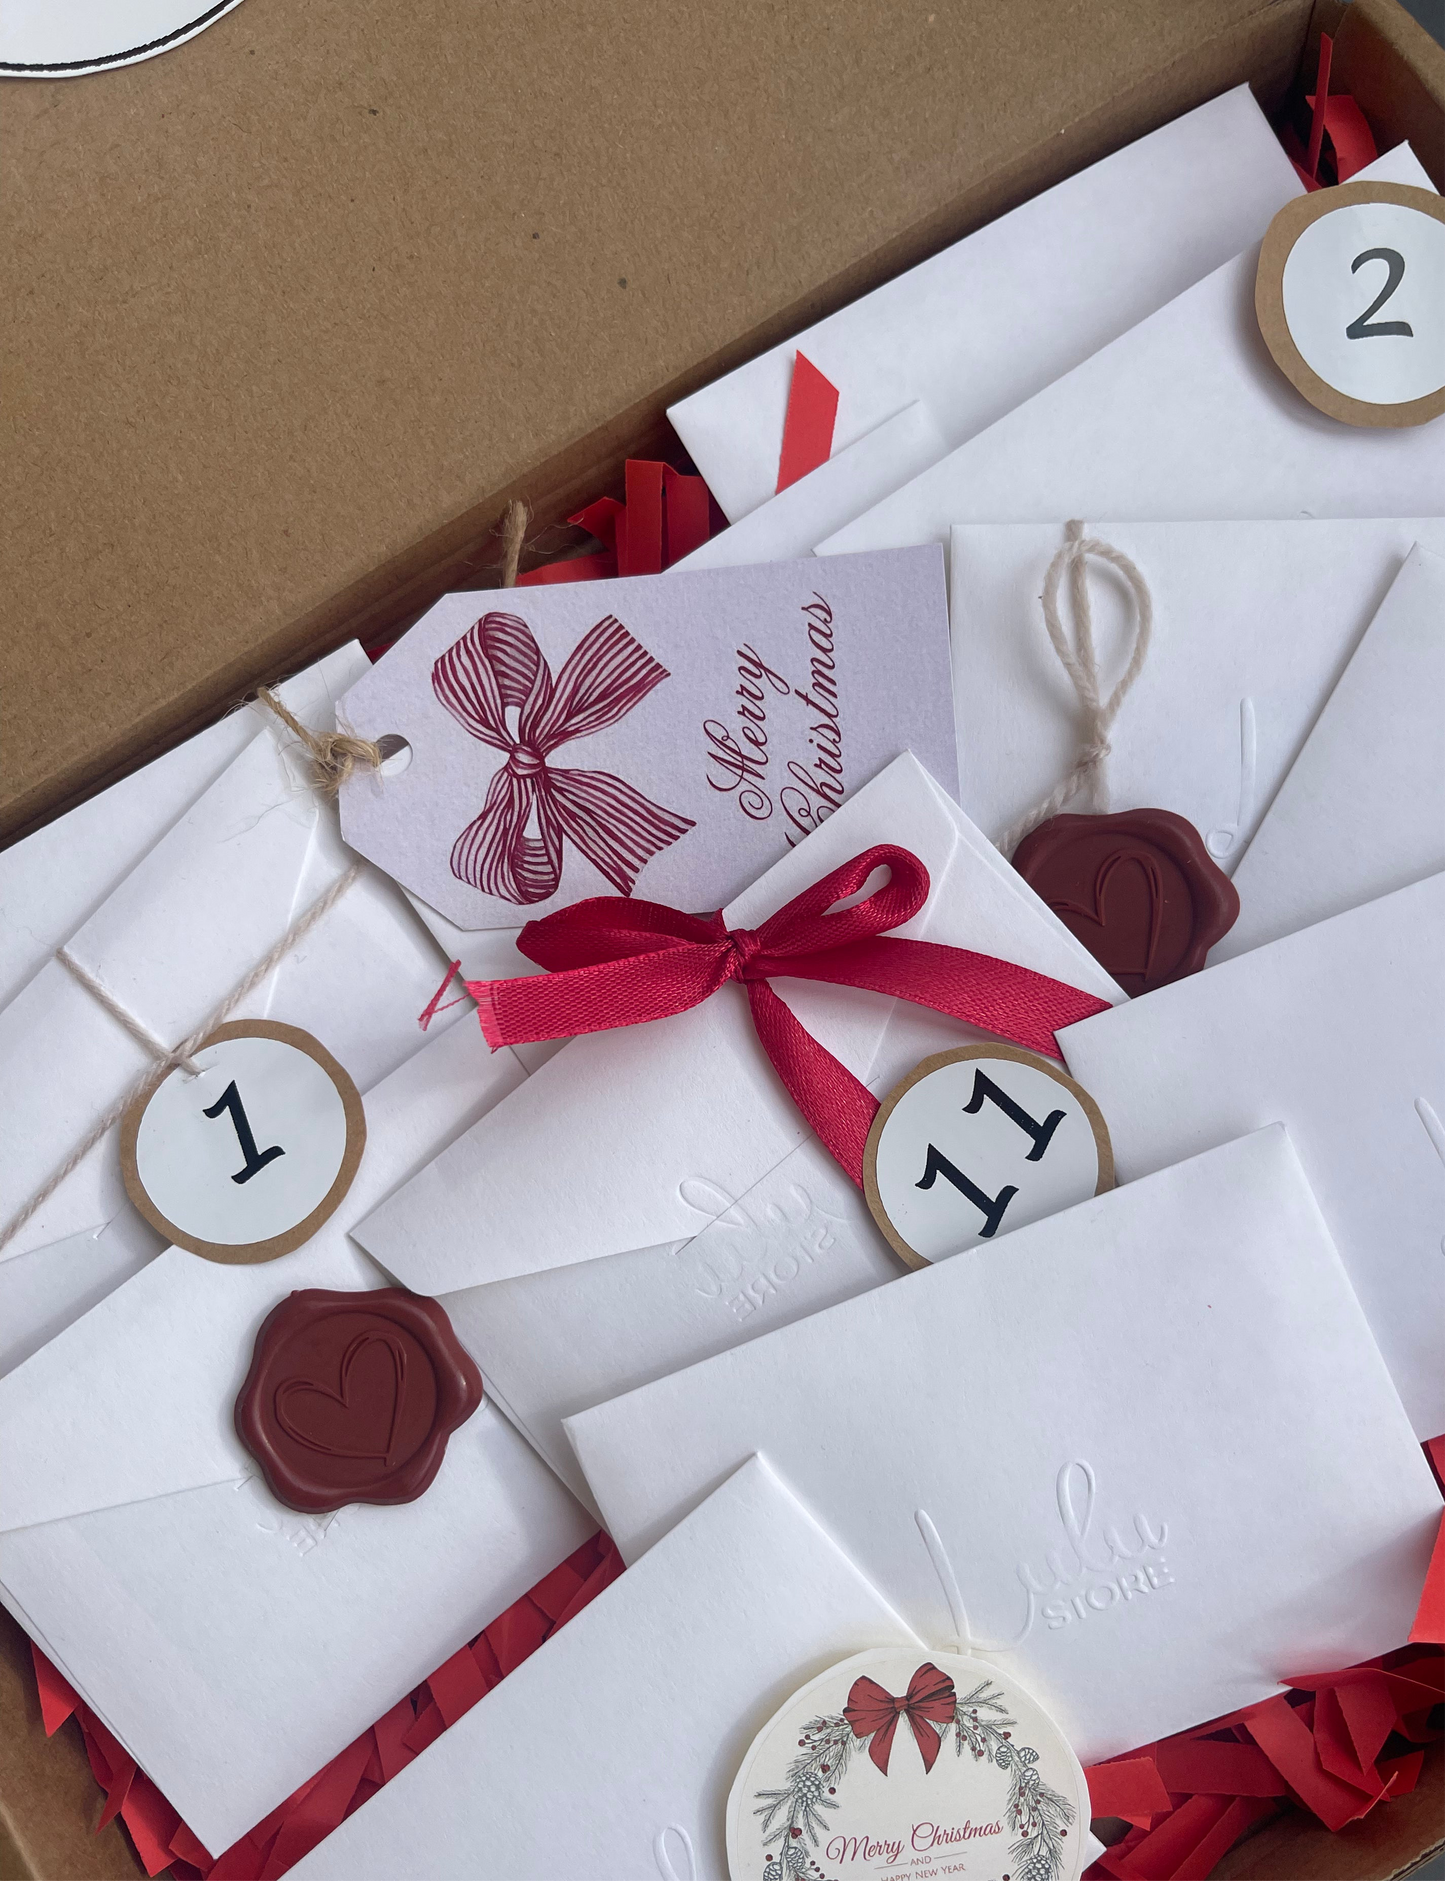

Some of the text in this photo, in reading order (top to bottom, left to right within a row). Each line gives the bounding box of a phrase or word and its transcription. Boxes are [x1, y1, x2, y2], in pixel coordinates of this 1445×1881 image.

[1346, 247, 1414, 339] 2
[703, 643, 790, 820] Merry
[202, 1079, 286, 1185] 1
[914, 1067, 1068, 1239] 11
[1041, 1555, 1176, 1630] STORE
[826, 1819, 1004, 1865] Merry Christmas
[910, 1855, 932, 1867] AND
[915, 1867, 939, 1880] NEW
[941, 1862, 967, 1876] YEAR
